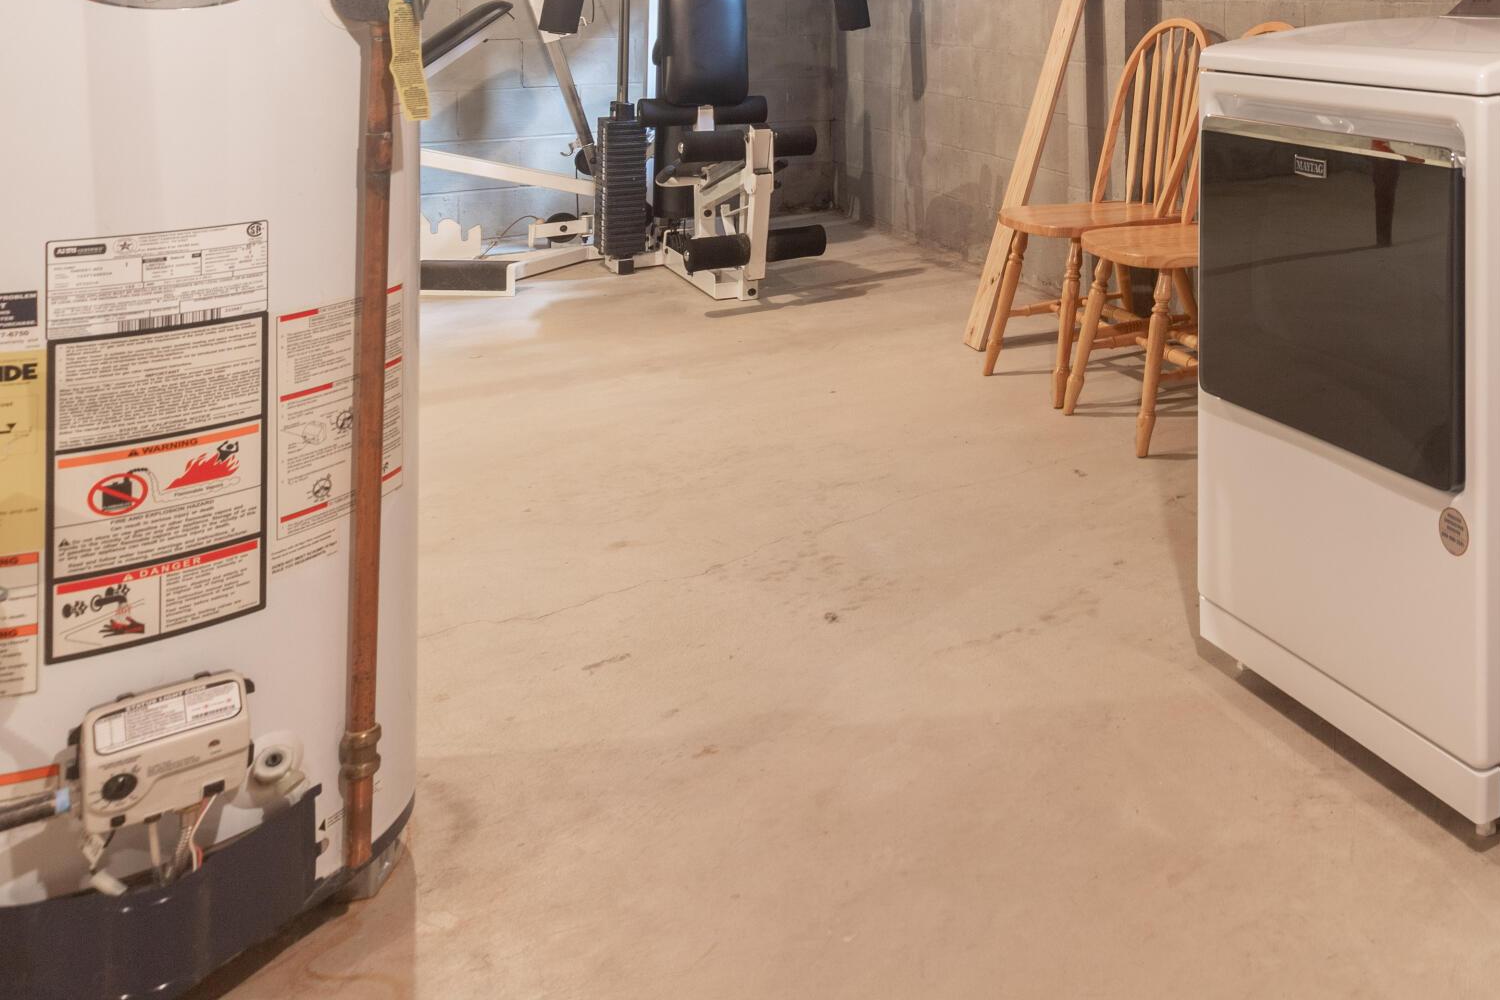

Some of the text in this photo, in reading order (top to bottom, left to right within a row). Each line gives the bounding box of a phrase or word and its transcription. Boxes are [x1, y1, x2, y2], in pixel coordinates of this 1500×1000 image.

[1296, 159, 1324, 175] MAYTAG
[142, 438, 199, 455] WARNING
[139, 555, 201, 578] DANGER
